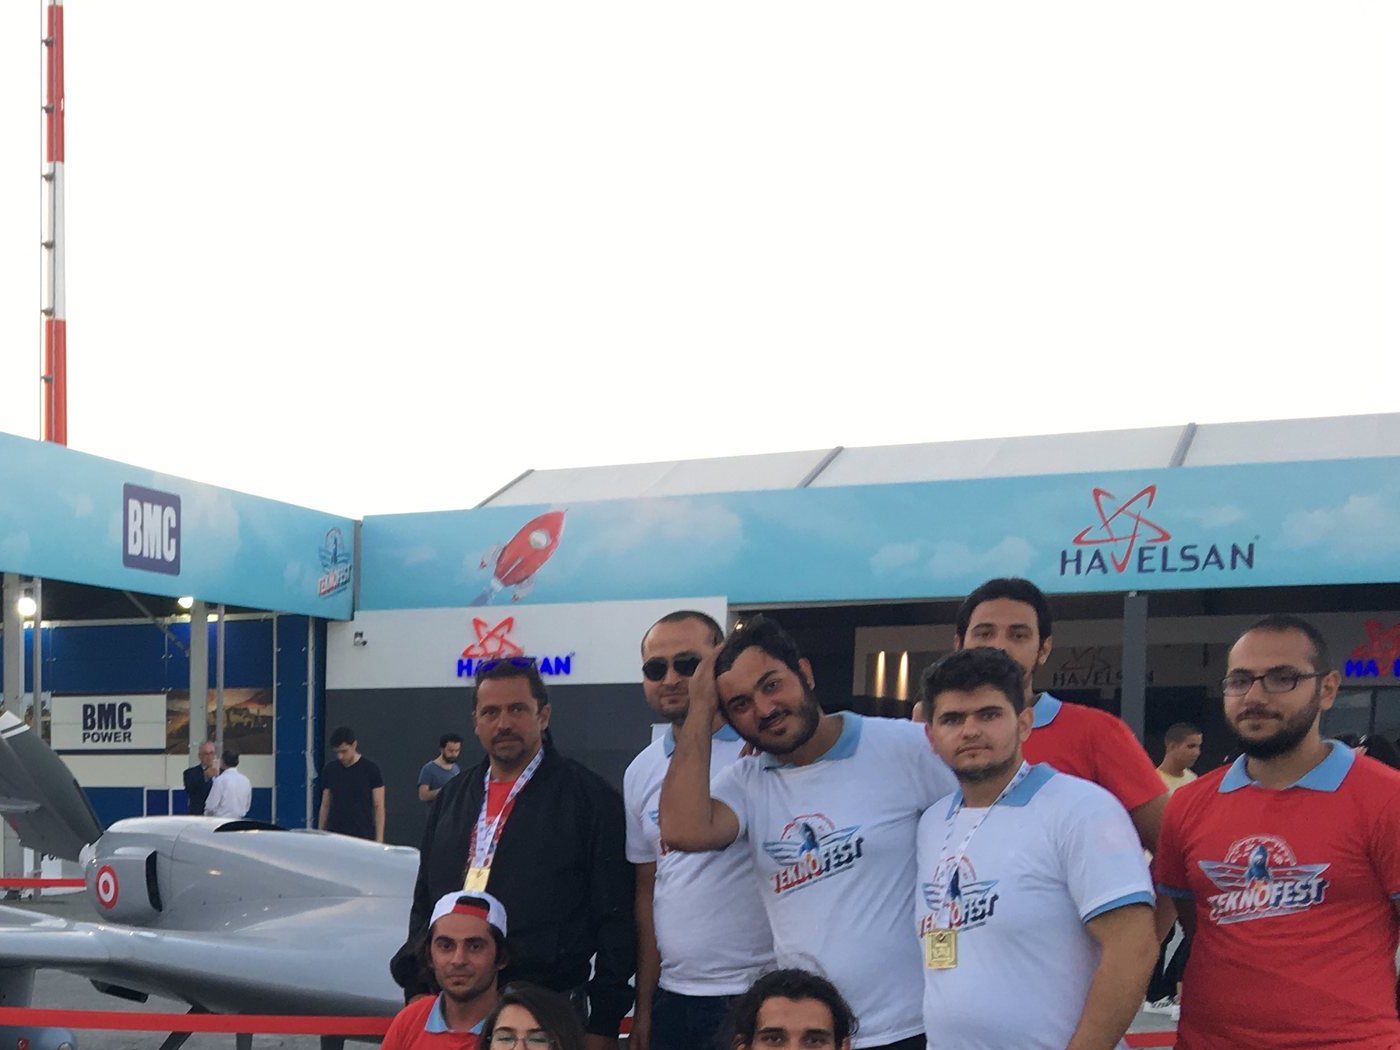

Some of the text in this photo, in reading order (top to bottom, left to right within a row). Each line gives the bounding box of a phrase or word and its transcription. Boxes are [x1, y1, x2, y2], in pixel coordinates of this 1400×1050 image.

[127, 498, 177, 563] BMC
[1059, 542, 1255, 576] HAVELSAN
[81, 702, 132, 731] BMC
[81, 731, 132, 744] POWER
[769, 837, 864, 894] TEKNOFEST
